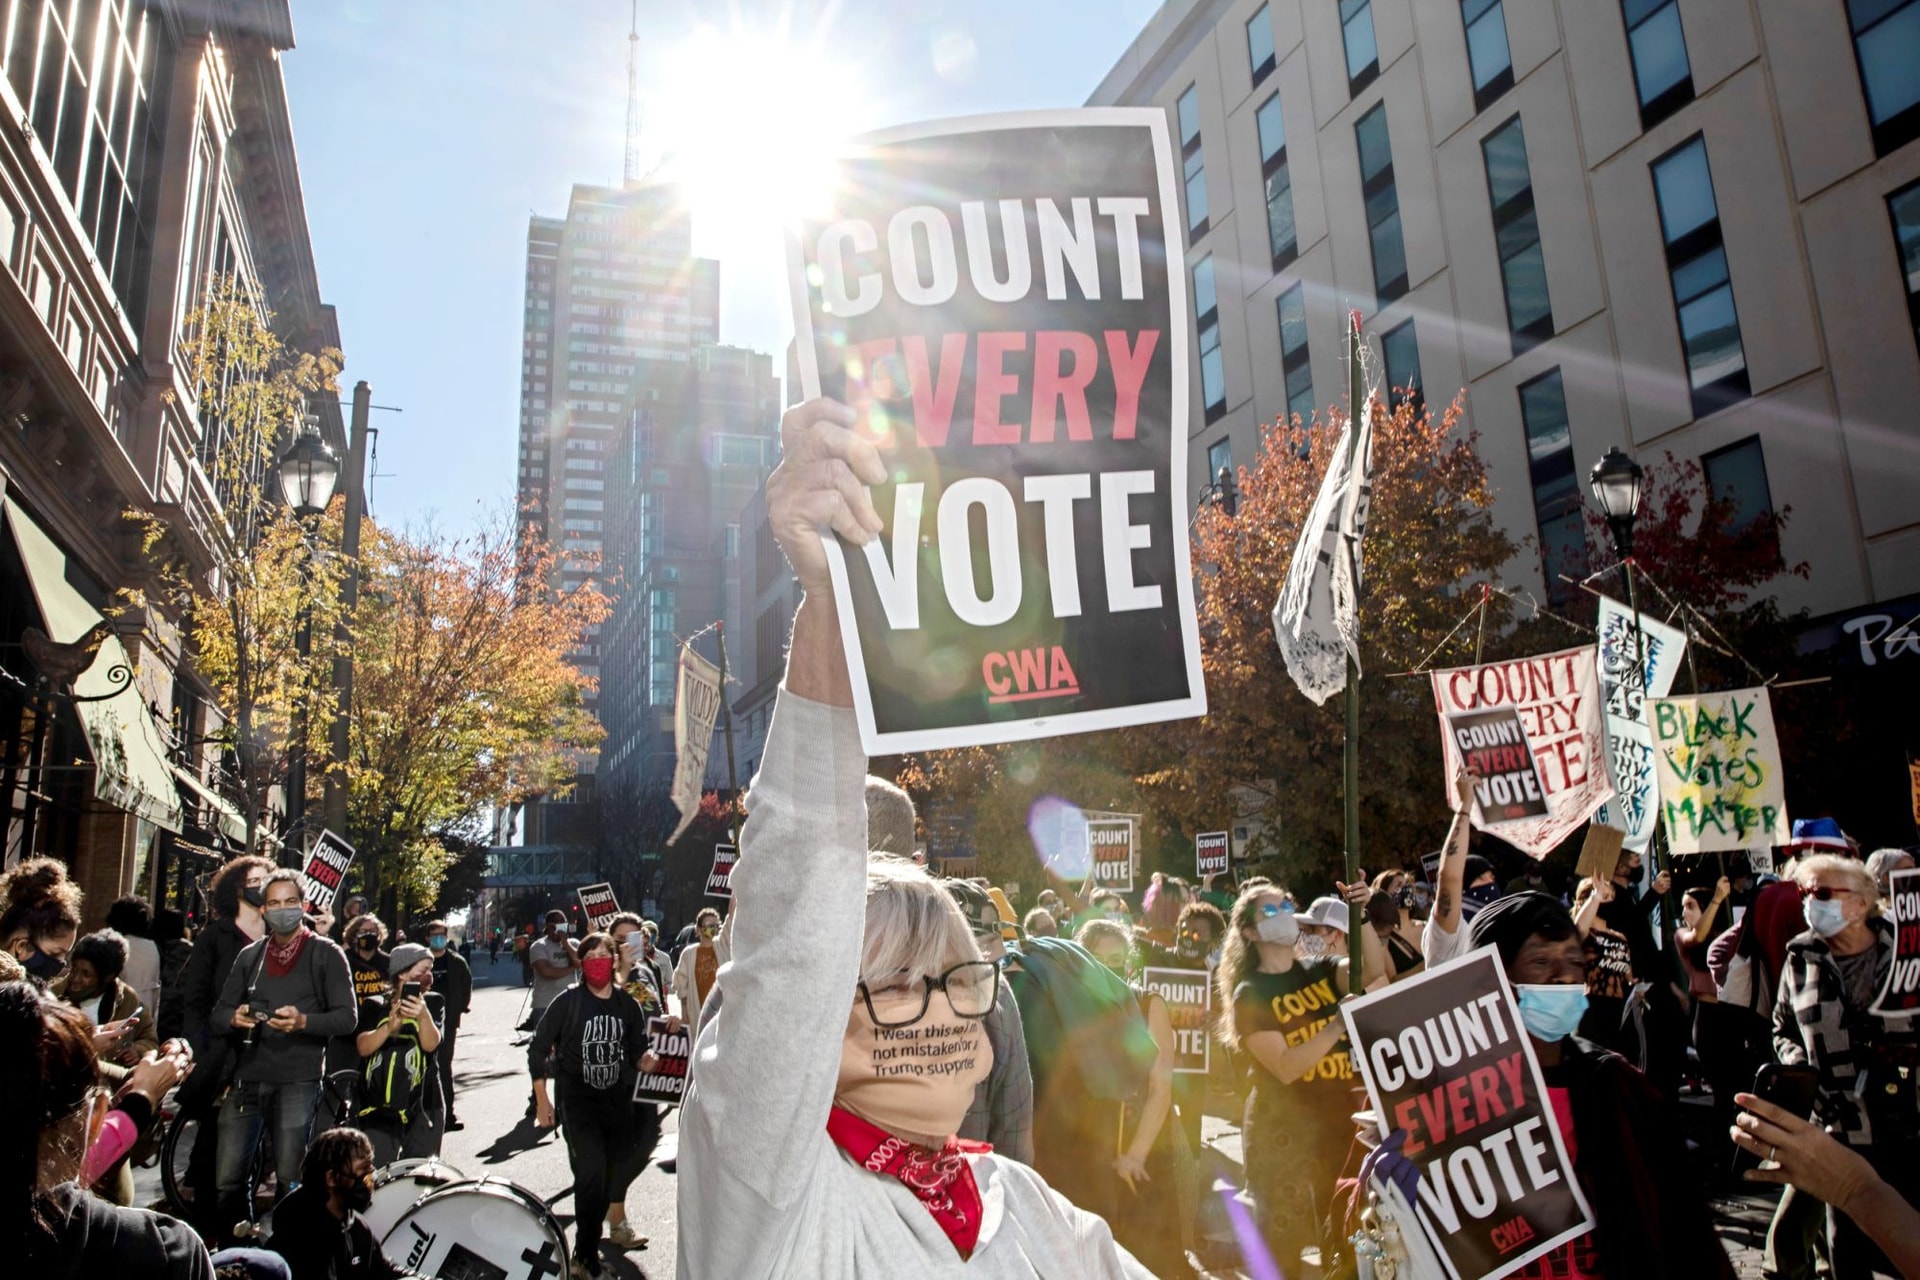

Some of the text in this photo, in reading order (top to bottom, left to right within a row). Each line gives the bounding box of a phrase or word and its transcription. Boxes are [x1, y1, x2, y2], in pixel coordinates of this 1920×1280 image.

[816, 196, 1150, 317] COUNT
[845, 329, 1160, 449] EVERY
[863, 469, 1163, 630] VOTE
[982, 646, 1080, 700] CWA
[1449, 651, 1582, 711] COUNT
[1518, 697, 1582, 738] ERY
[1456, 719, 1522, 751] COUNT
[1467, 744, 1528, 776] EVERY
[1533, 733, 1588, 796] TE
[1475, 769, 1541, 809] VOTE
[1090, 830, 1129, 845] COUNT
[1199, 838, 1225, 848] COUNT
[316, 842, 349, 872] COUNT
[1200, 856, 1226, 869] VOTE
[307, 859, 341, 888] EVERY
[710, 874, 729, 887] VOT
[583, 890, 612, 906] COUNT
[1170, 1005, 1205, 1028] ERY
[1271, 977, 1338, 1025] COUN
[874, 1027, 879, 1041] I
[882, 1028, 921, 1041] wear
[925, 1024, 951, 1038] this
[1172, 1029, 1204, 1055] TE
[1370, 991, 1510, 1093] COUNT
[657, 1056, 685, 1077] EVE
[873, 1047, 897, 1060] not
[901, 1041, 961, 1057] mistaken
[872, 1057, 975, 1077] Trump supprter
[640, 1076, 684, 1094] COUNT
[1394, 1052, 1527, 1158] EVERY
[1416, 1116, 1560, 1235] VOTE
[1490, 1216, 1534, 1251] CWA
